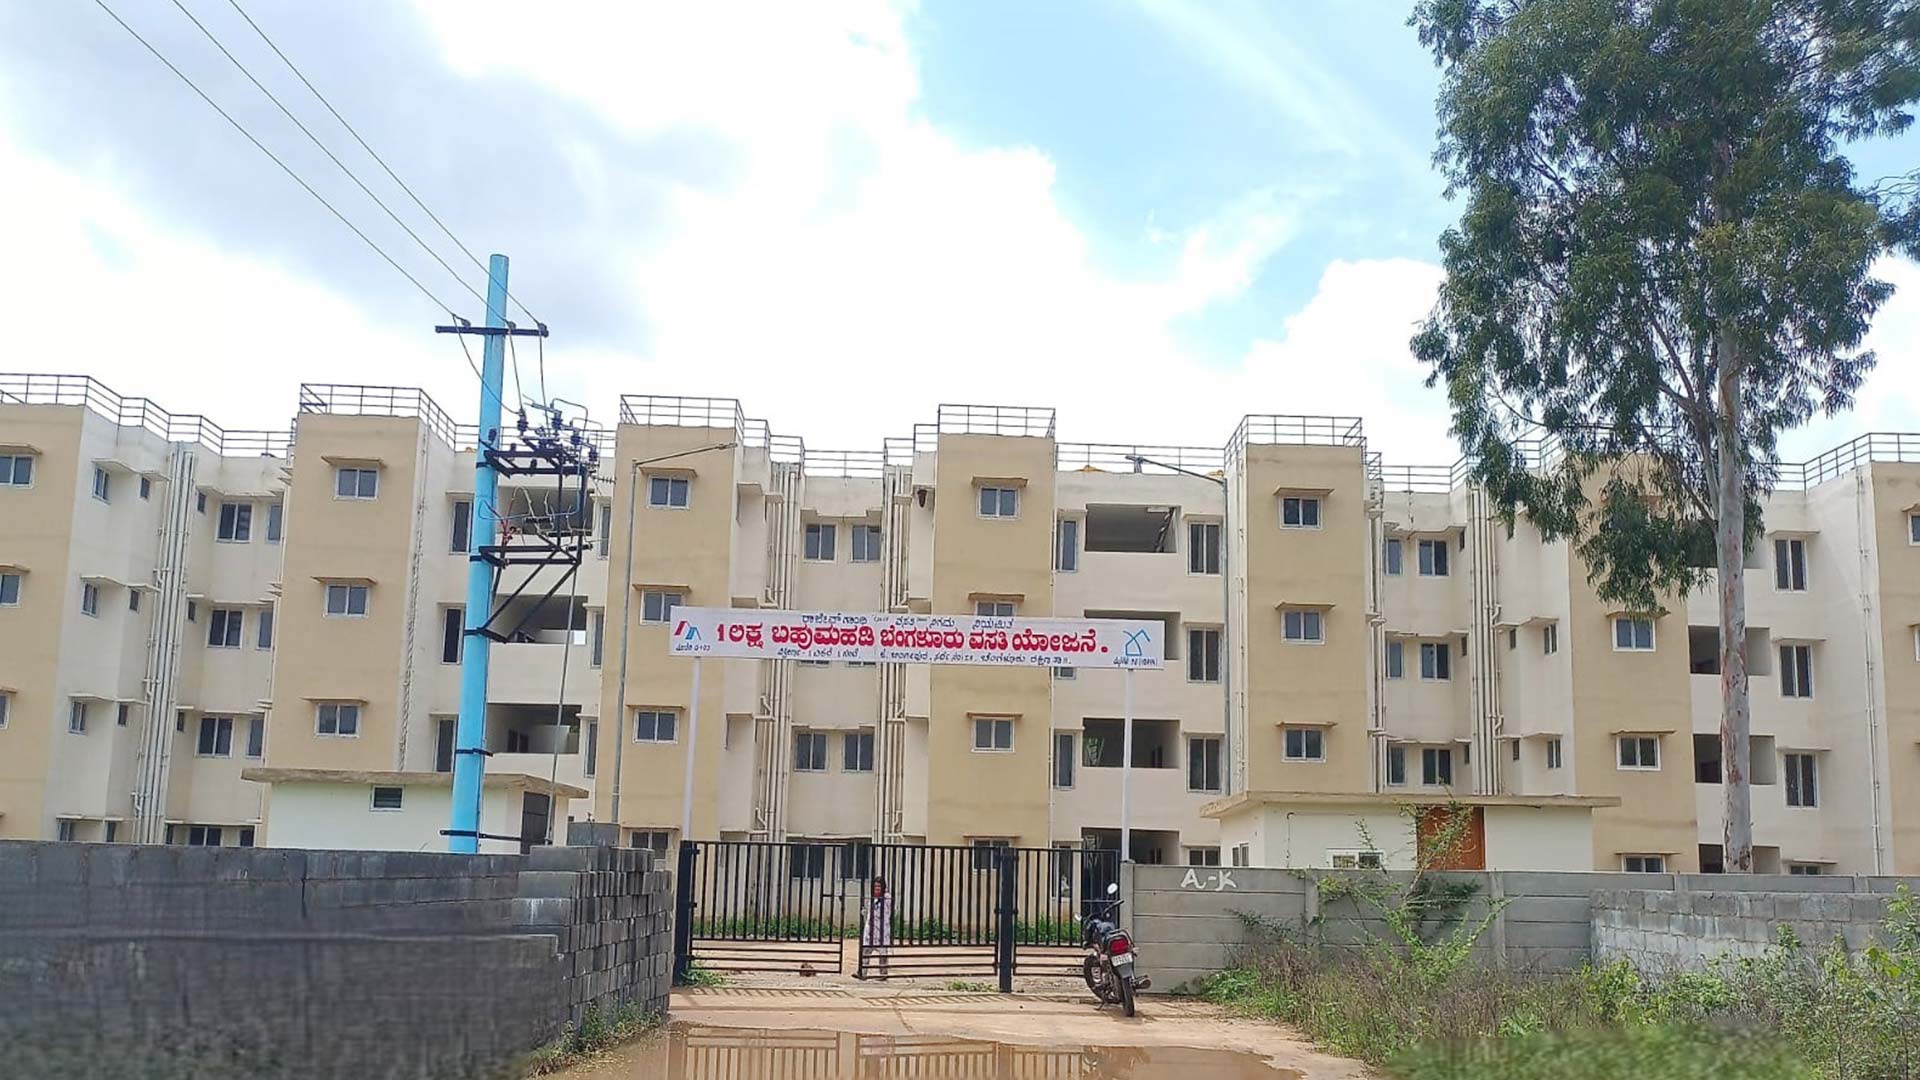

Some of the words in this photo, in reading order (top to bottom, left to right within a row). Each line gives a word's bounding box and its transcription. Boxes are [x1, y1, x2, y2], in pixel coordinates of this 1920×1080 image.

[772, 623, 875, 650] ಬಹುಮಹಡಿ
[880, 625, 965, 649] ಬೆಂಗಳೂರು
[969, 628, 1009, 650] ವಸತಿ
[1181, 868, 1237, 892] A-K
